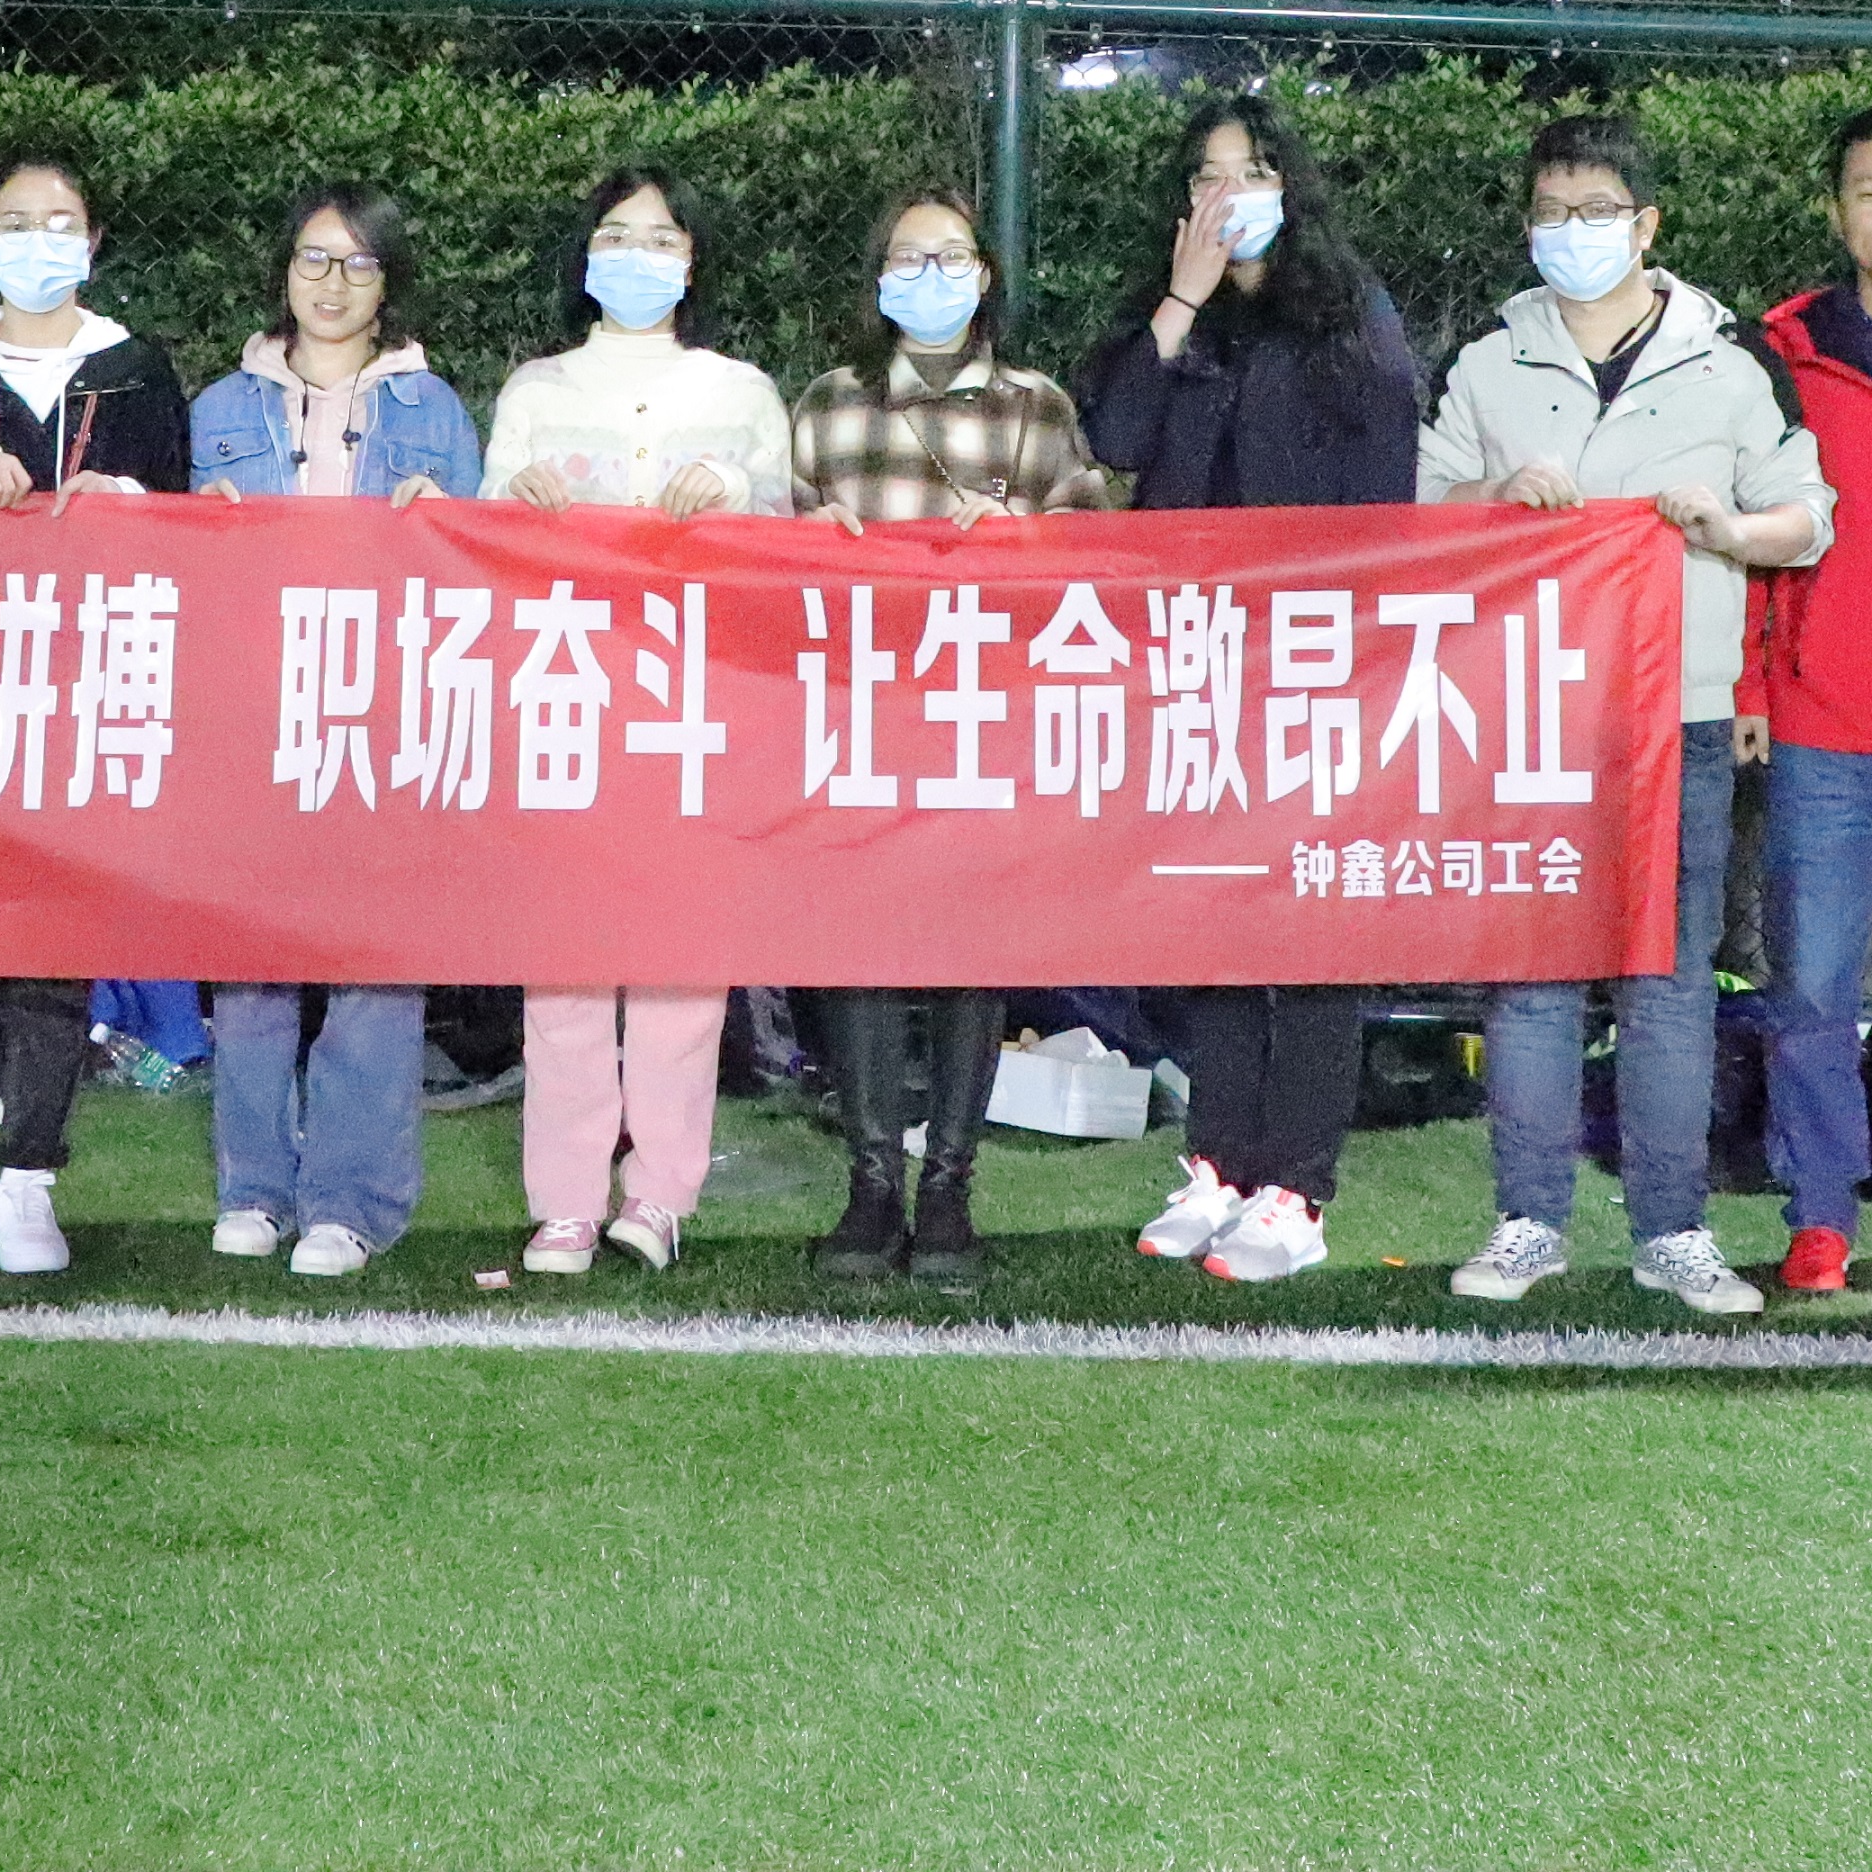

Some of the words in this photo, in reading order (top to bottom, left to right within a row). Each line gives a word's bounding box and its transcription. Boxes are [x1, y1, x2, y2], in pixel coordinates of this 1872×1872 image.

[272, 577, 727, 817] 职场奋斗
[796, 578, 1593, 818] 让生命激昂不止
